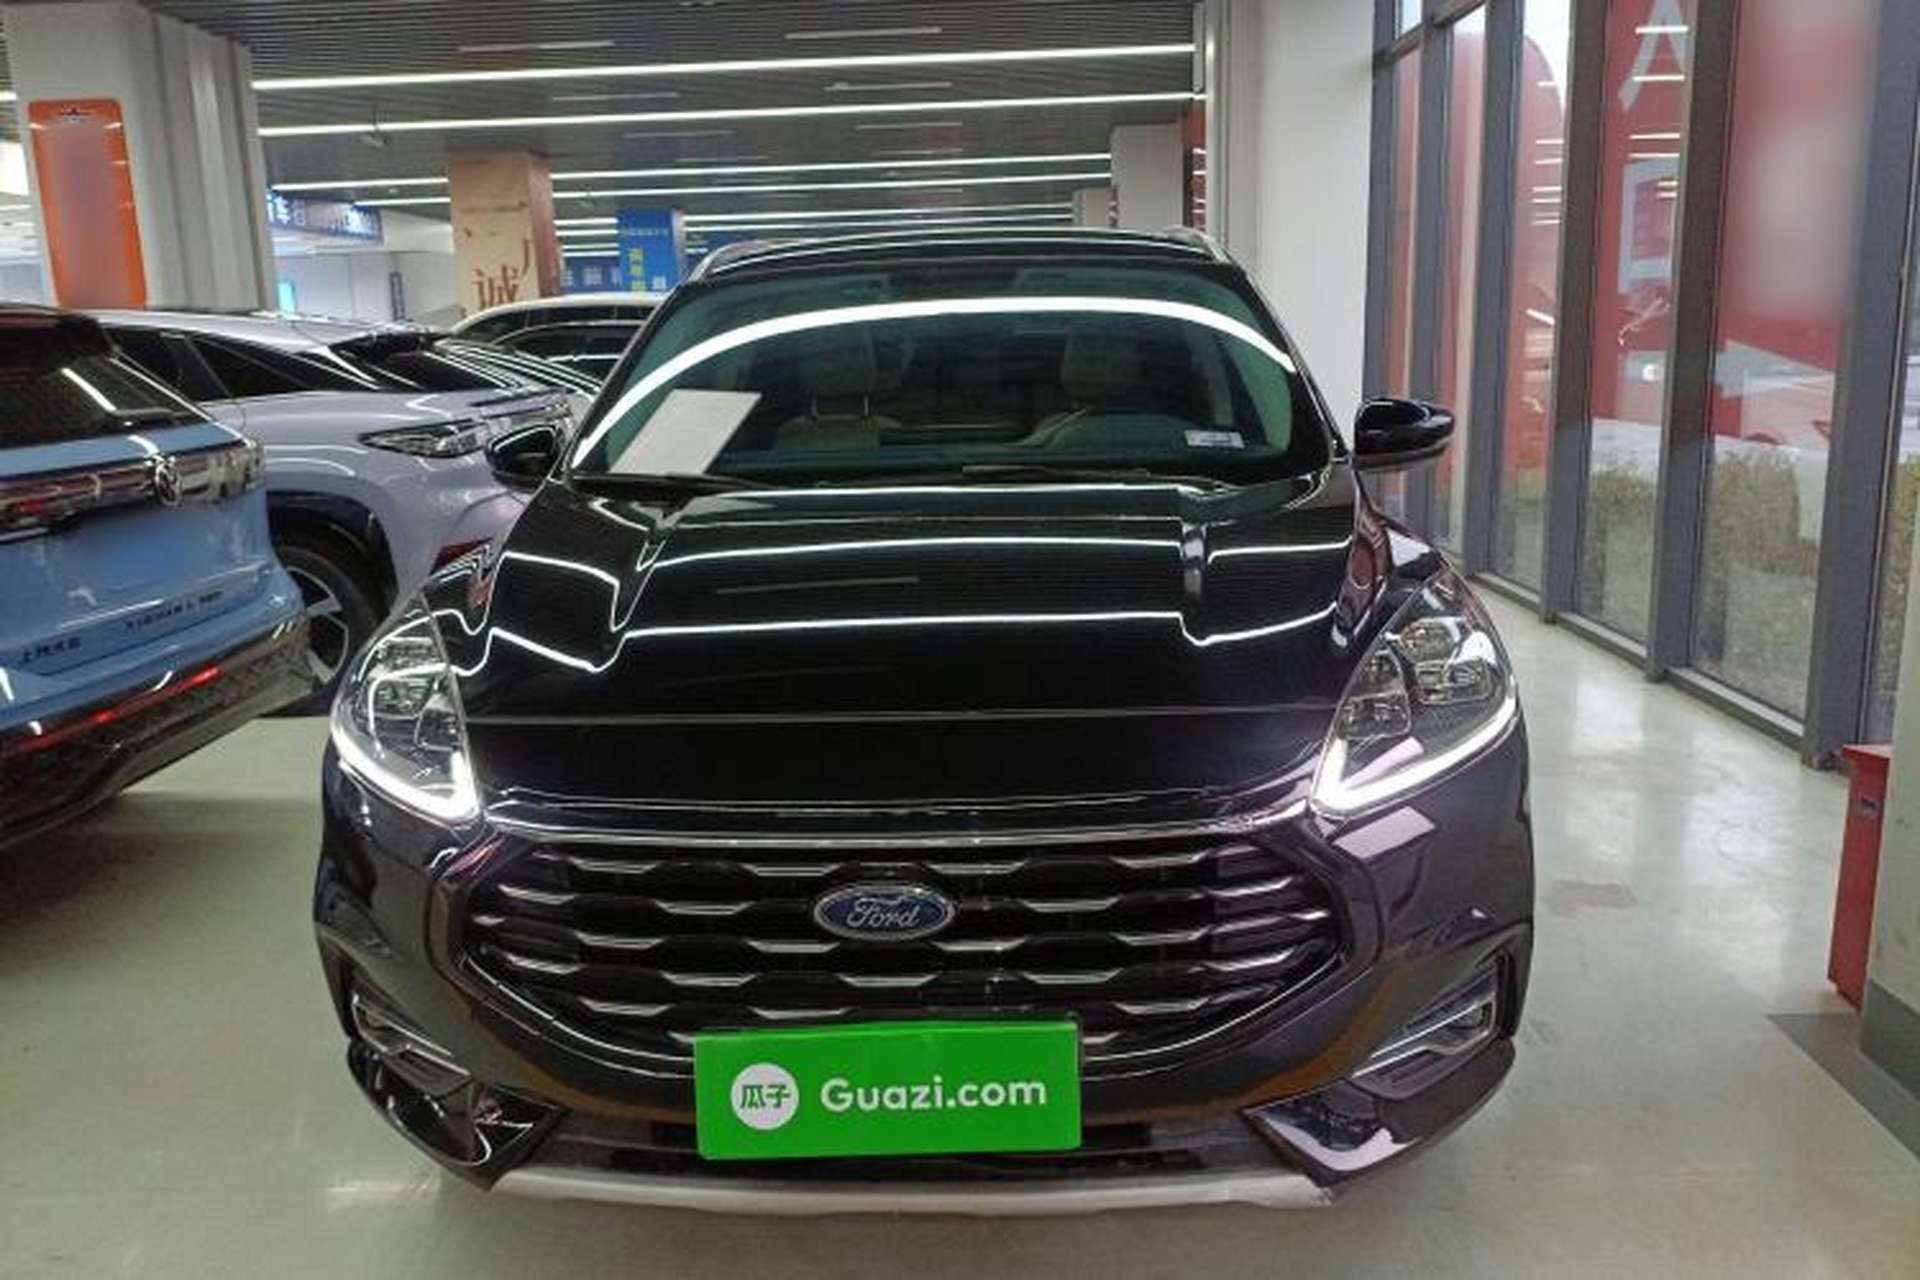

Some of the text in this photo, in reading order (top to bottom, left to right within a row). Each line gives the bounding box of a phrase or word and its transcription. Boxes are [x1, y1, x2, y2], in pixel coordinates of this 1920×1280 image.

[847, 897, 920, 928] Ford
[740, 1083, 792, 1110] 瓜子
[820, 1074, 1048, 1113] Guazi.com
